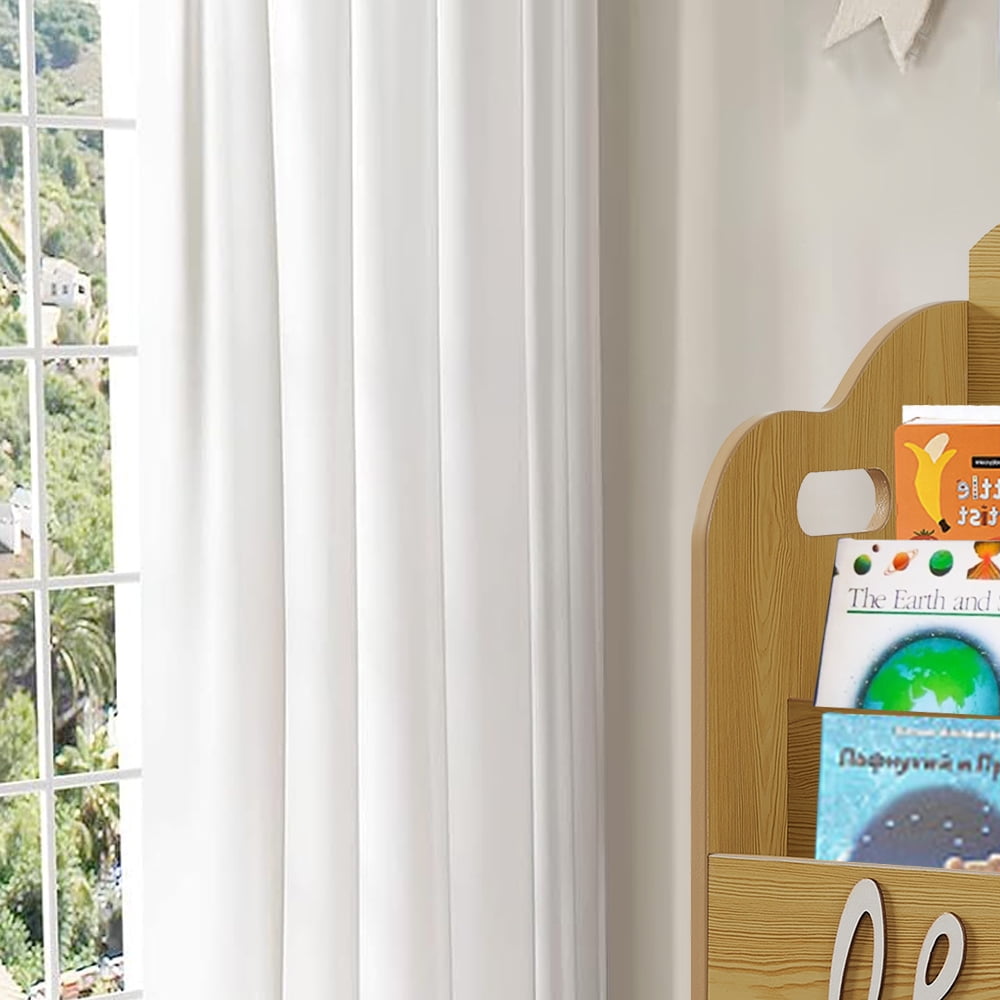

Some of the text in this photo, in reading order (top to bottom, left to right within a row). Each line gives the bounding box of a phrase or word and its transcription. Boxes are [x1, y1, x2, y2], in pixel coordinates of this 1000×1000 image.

[847, 587, 886, 609] The
[893, 589, 946, 611] Earth
[952, 591, 991, 612] and
